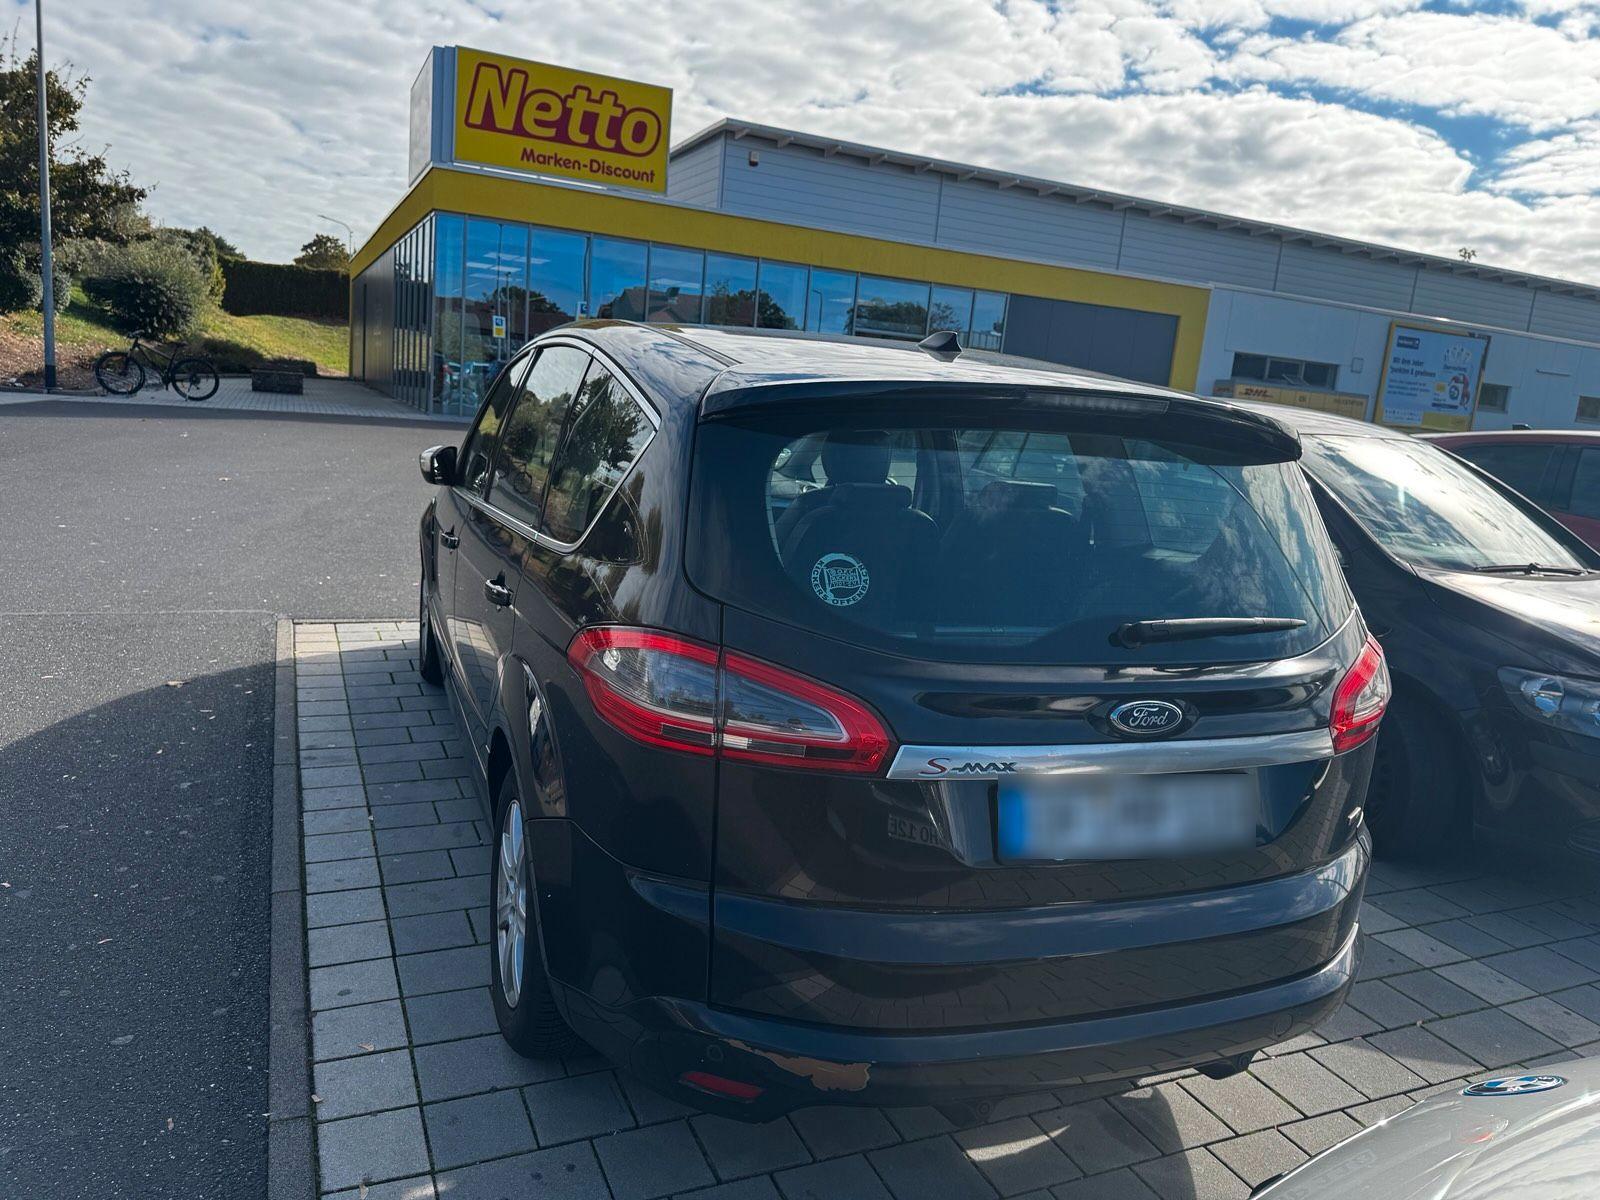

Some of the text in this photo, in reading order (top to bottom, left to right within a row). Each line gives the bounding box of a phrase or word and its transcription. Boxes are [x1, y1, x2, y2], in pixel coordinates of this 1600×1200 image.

[464, 62, 661, 157] Netto
[520, 147, 655, 183] Marken-Discount
[812, 559, 829, 601] KICKERS
[1129, 707, 1169, 727] Ford
[918, 757, 1018, 775] S-MAX
